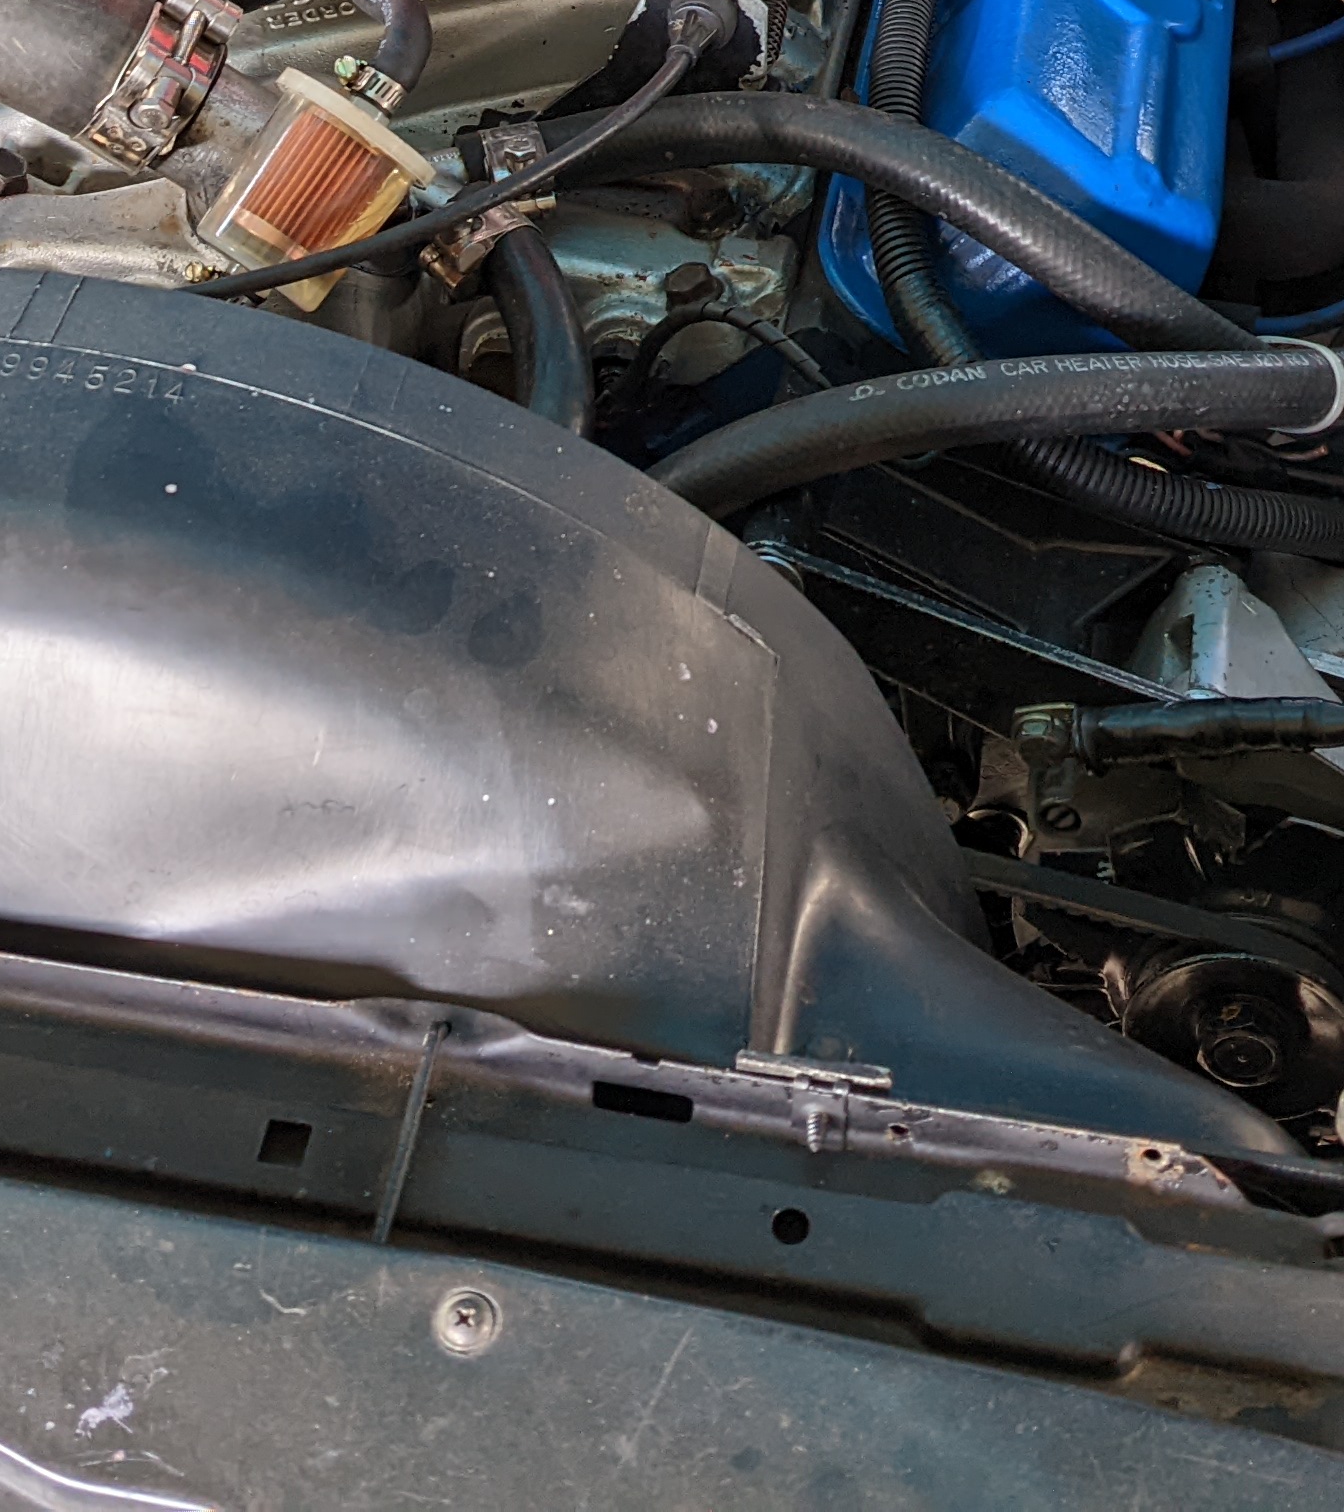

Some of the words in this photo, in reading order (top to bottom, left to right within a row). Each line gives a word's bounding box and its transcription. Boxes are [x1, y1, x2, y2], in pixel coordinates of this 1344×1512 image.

[266, 1, 356, 30] ORDER
[896, 365, 987, 390] CODAN
[1000, 360, 1050, 377] CAR
[1054, 355, 1143, 373] HEATER
[1148, 353, 1206, 369] HOSE
[1206, 353, 1251, 368] SAE
